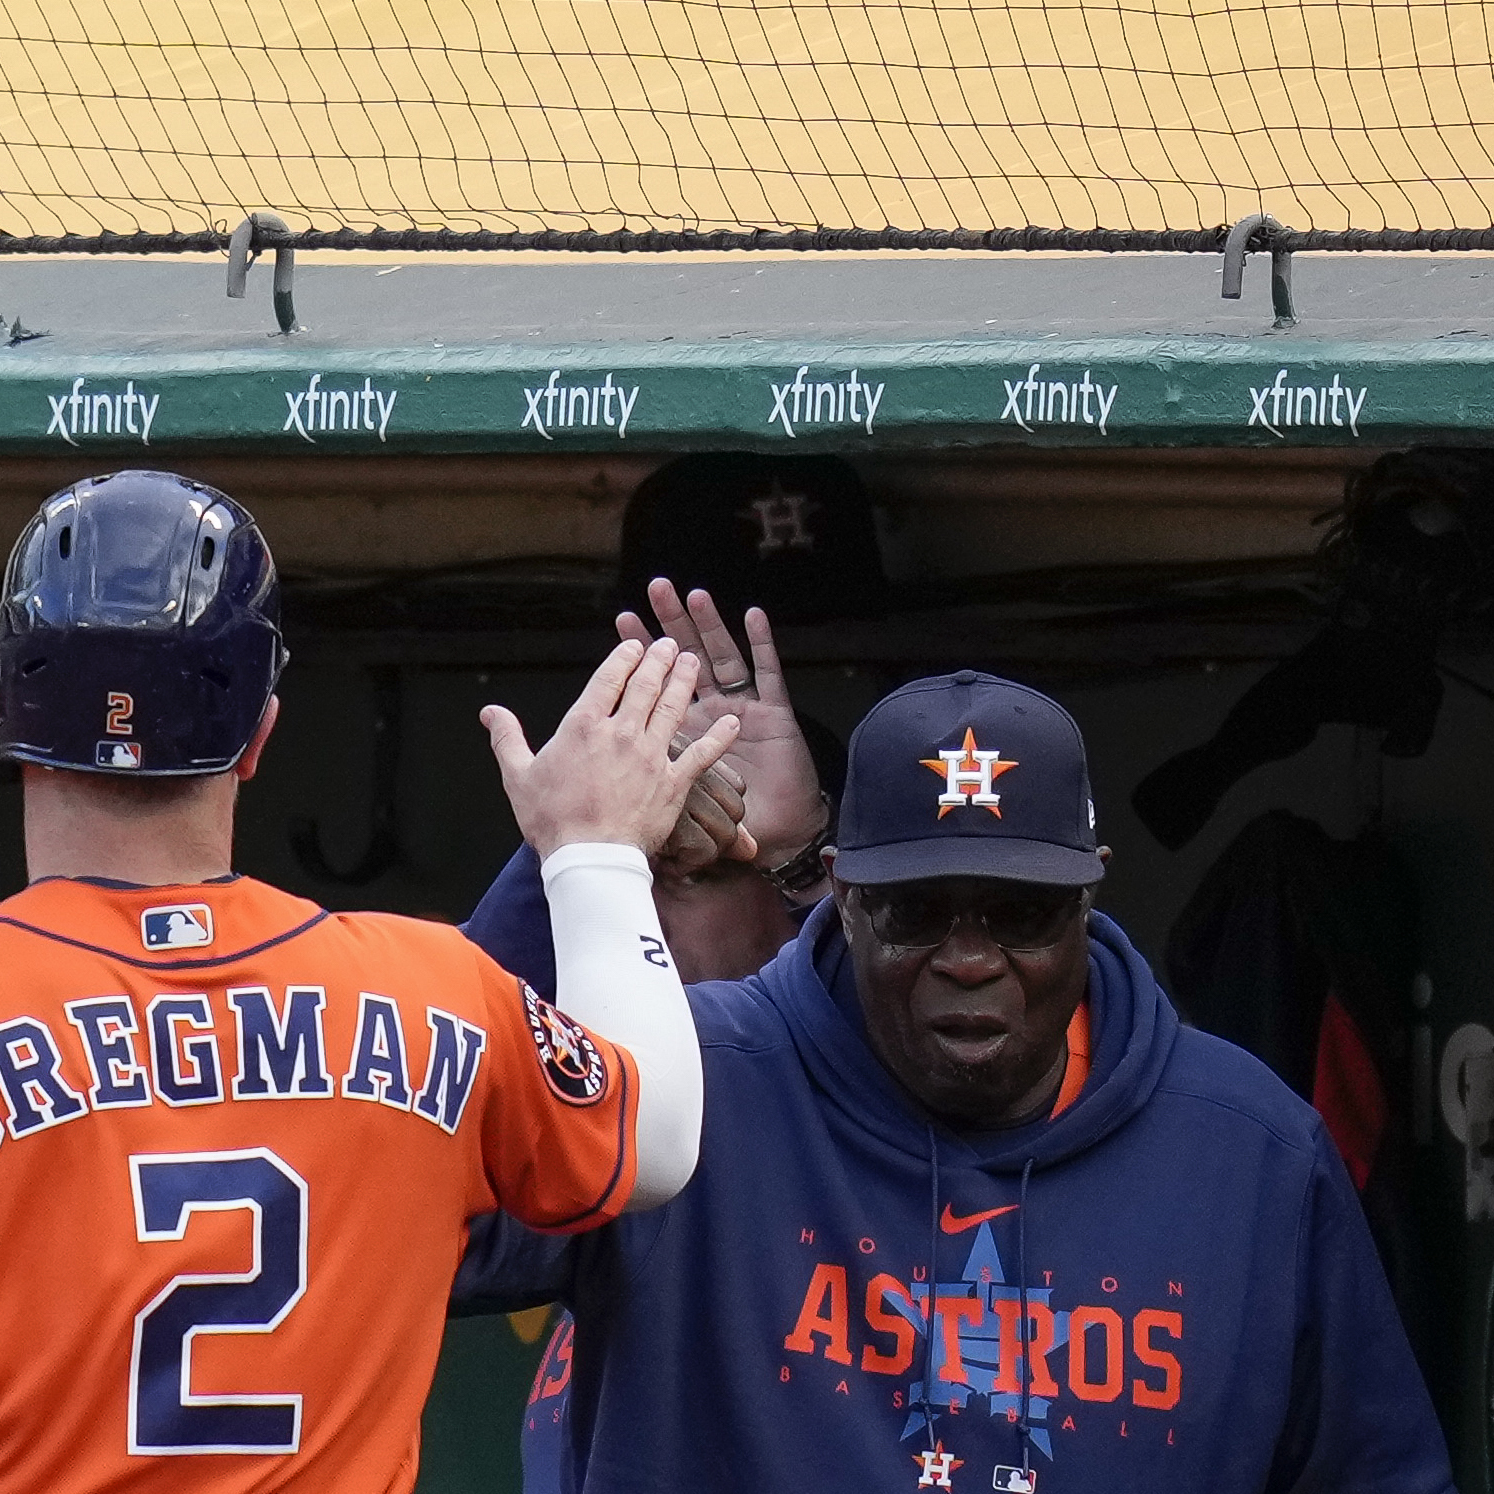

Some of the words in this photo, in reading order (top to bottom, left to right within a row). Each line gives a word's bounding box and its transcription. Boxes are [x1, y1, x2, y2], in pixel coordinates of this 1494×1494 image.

[47, 377, 160, 446] xfinity
[284, 373, 397, 443] xfinity
[521, 370, 639, 441] xfinity
[768, 367, 884, 438] xfinity
[1002, 368, 1118, 437] xfinity
[1248, 370, 1367, 438] xfinity
[106, 691, 133, 735] 2
[938, 748, 1000, 807] H
[126, 1146, 309, 1456] 2
[783, 1262, 1184, 1411] ASTROS
